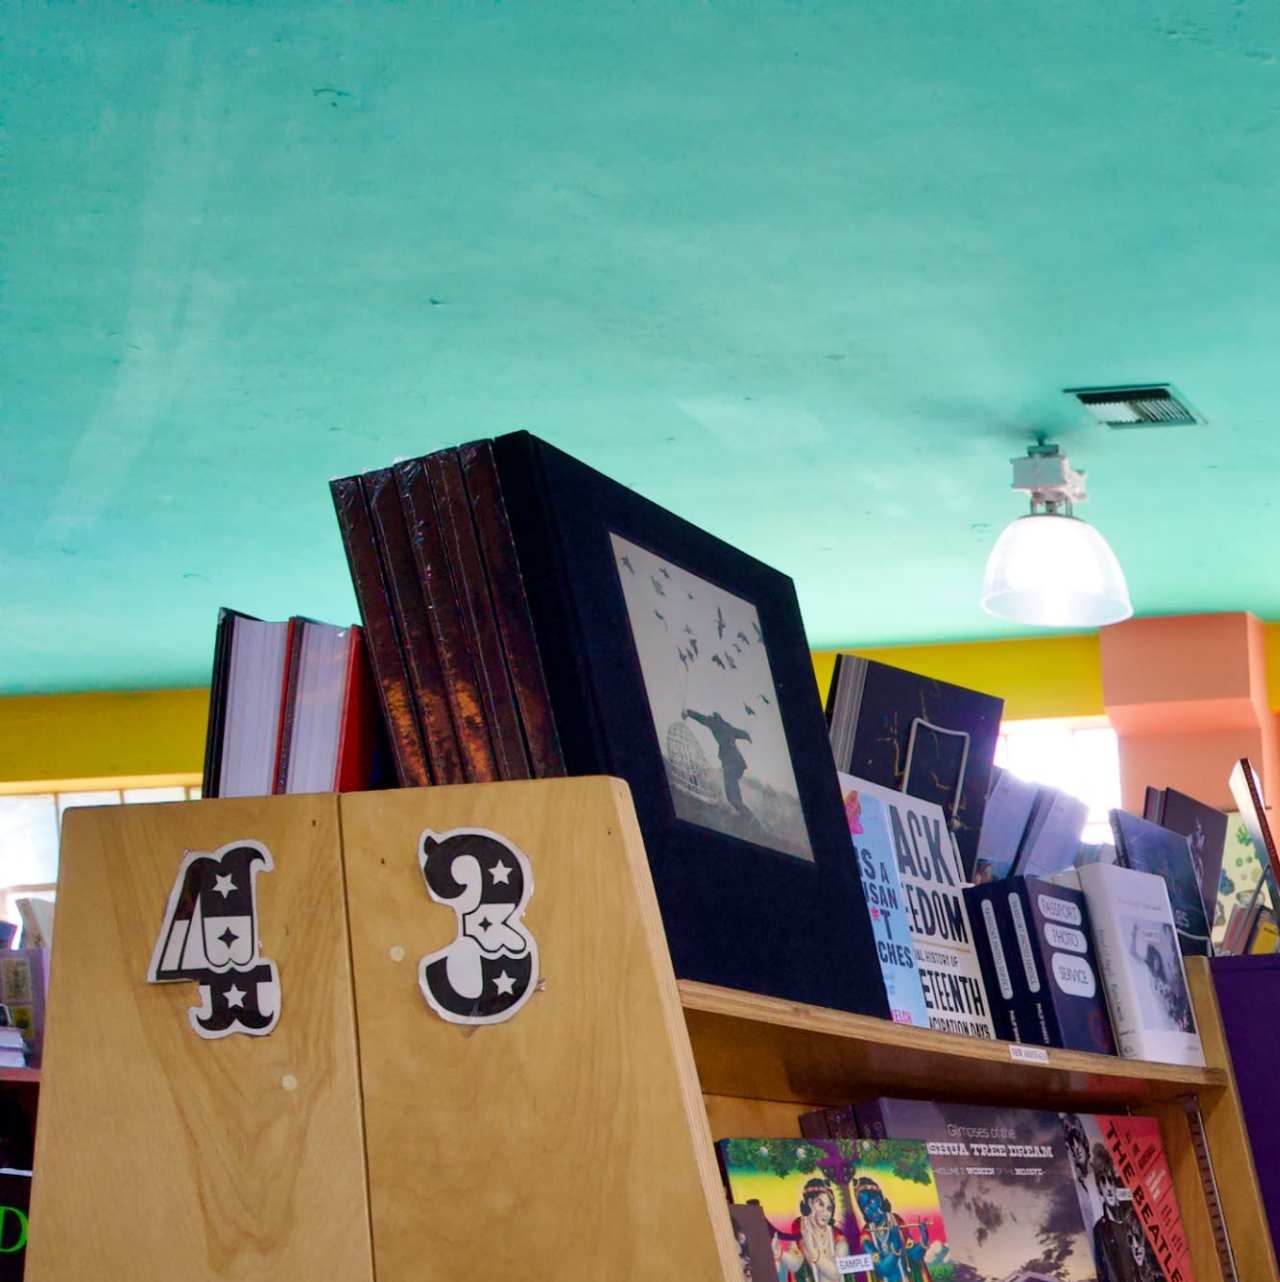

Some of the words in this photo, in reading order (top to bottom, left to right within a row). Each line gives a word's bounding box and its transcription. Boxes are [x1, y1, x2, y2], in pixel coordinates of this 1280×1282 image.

[150, 845, 276, 1032] 4
[424, 832, 534, 1018] 3
[970, 1143, 1008, 1157] TREE
[1007, 1145, 1054, 1158] DREAM
[1106, 1119, 1136, 1184] THE
